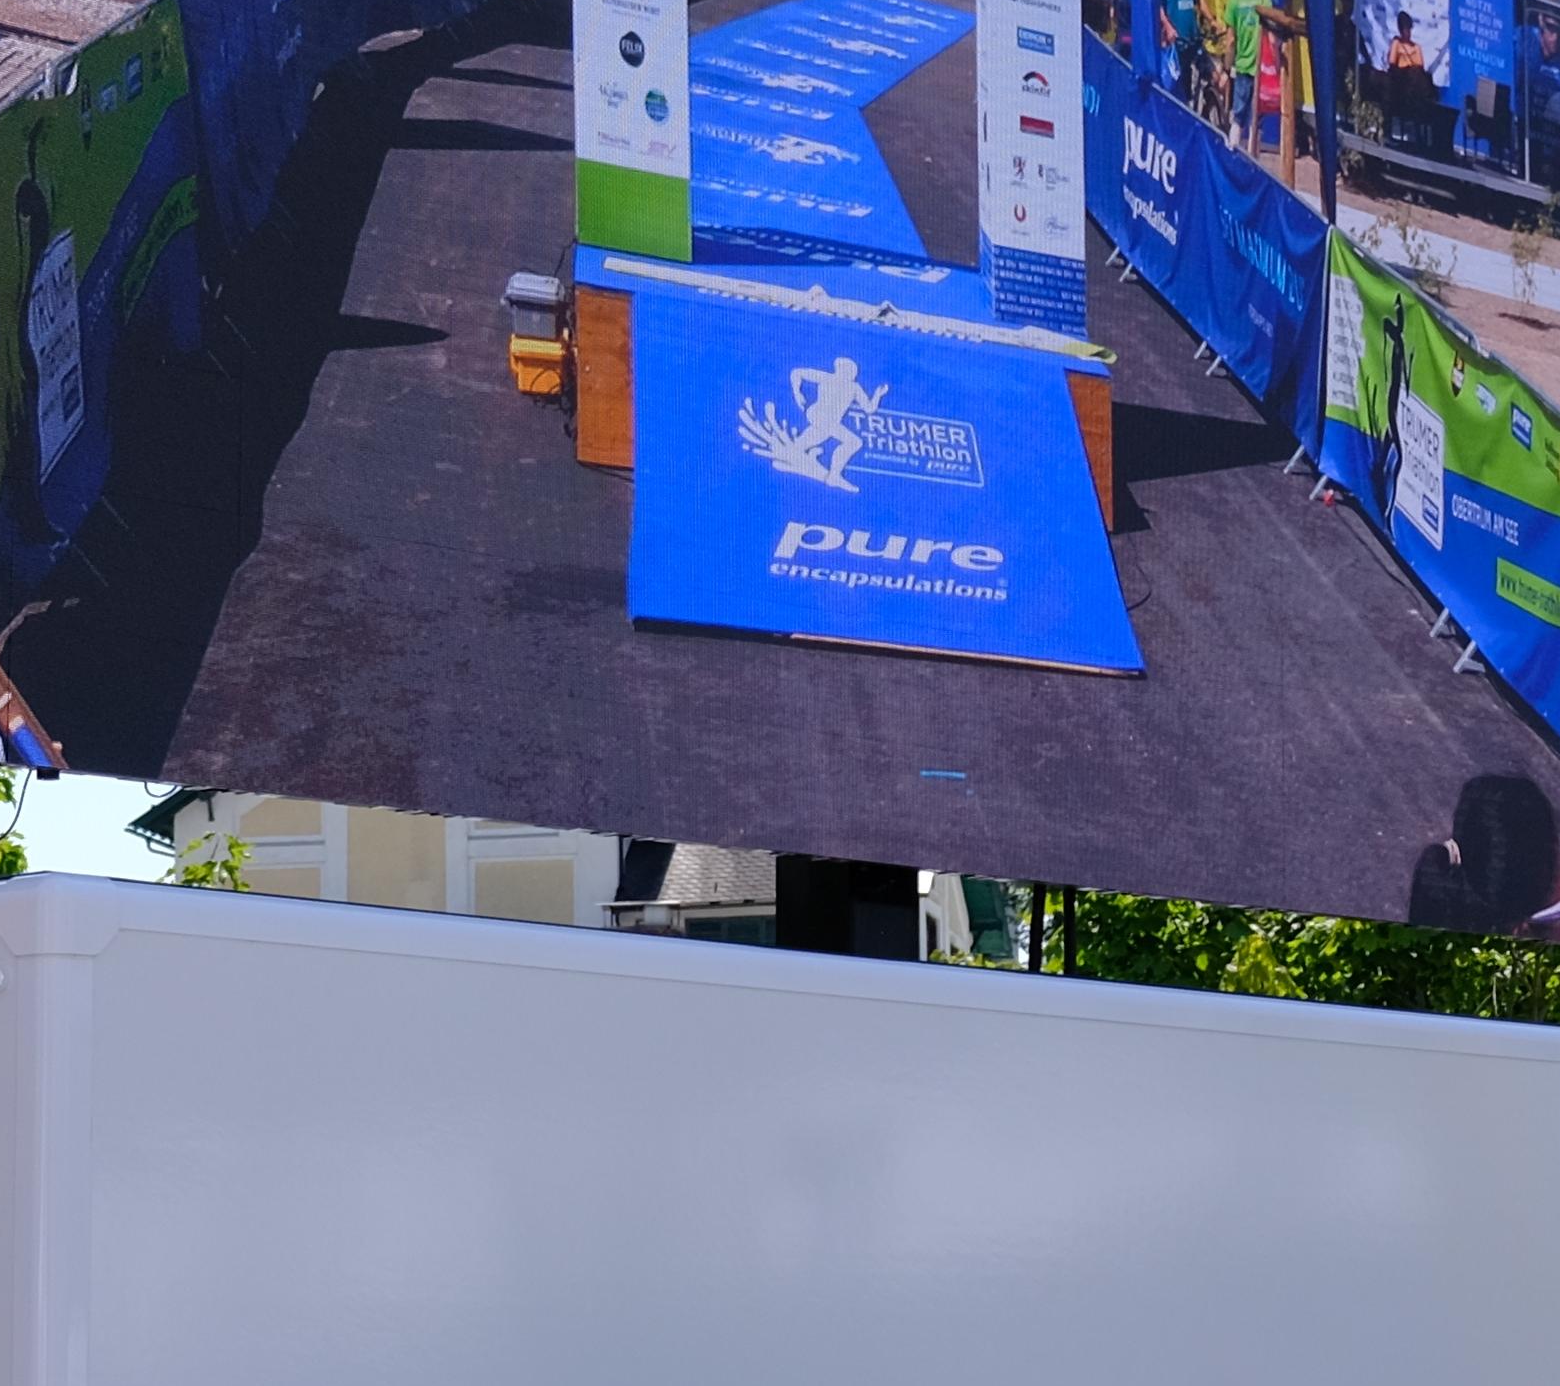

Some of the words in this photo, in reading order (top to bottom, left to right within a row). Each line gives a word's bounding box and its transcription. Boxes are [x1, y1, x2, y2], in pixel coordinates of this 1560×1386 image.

[1122, 115, 1177, 195] pure
[848, 410, 968, 447] TRUMER
[861, 430, 972, 464] Triathlon
[772, 519, 1005, 572] pure
[1503, 518, 1520, 547] SEE
[768, 559, 1008, 602] encapsulations
